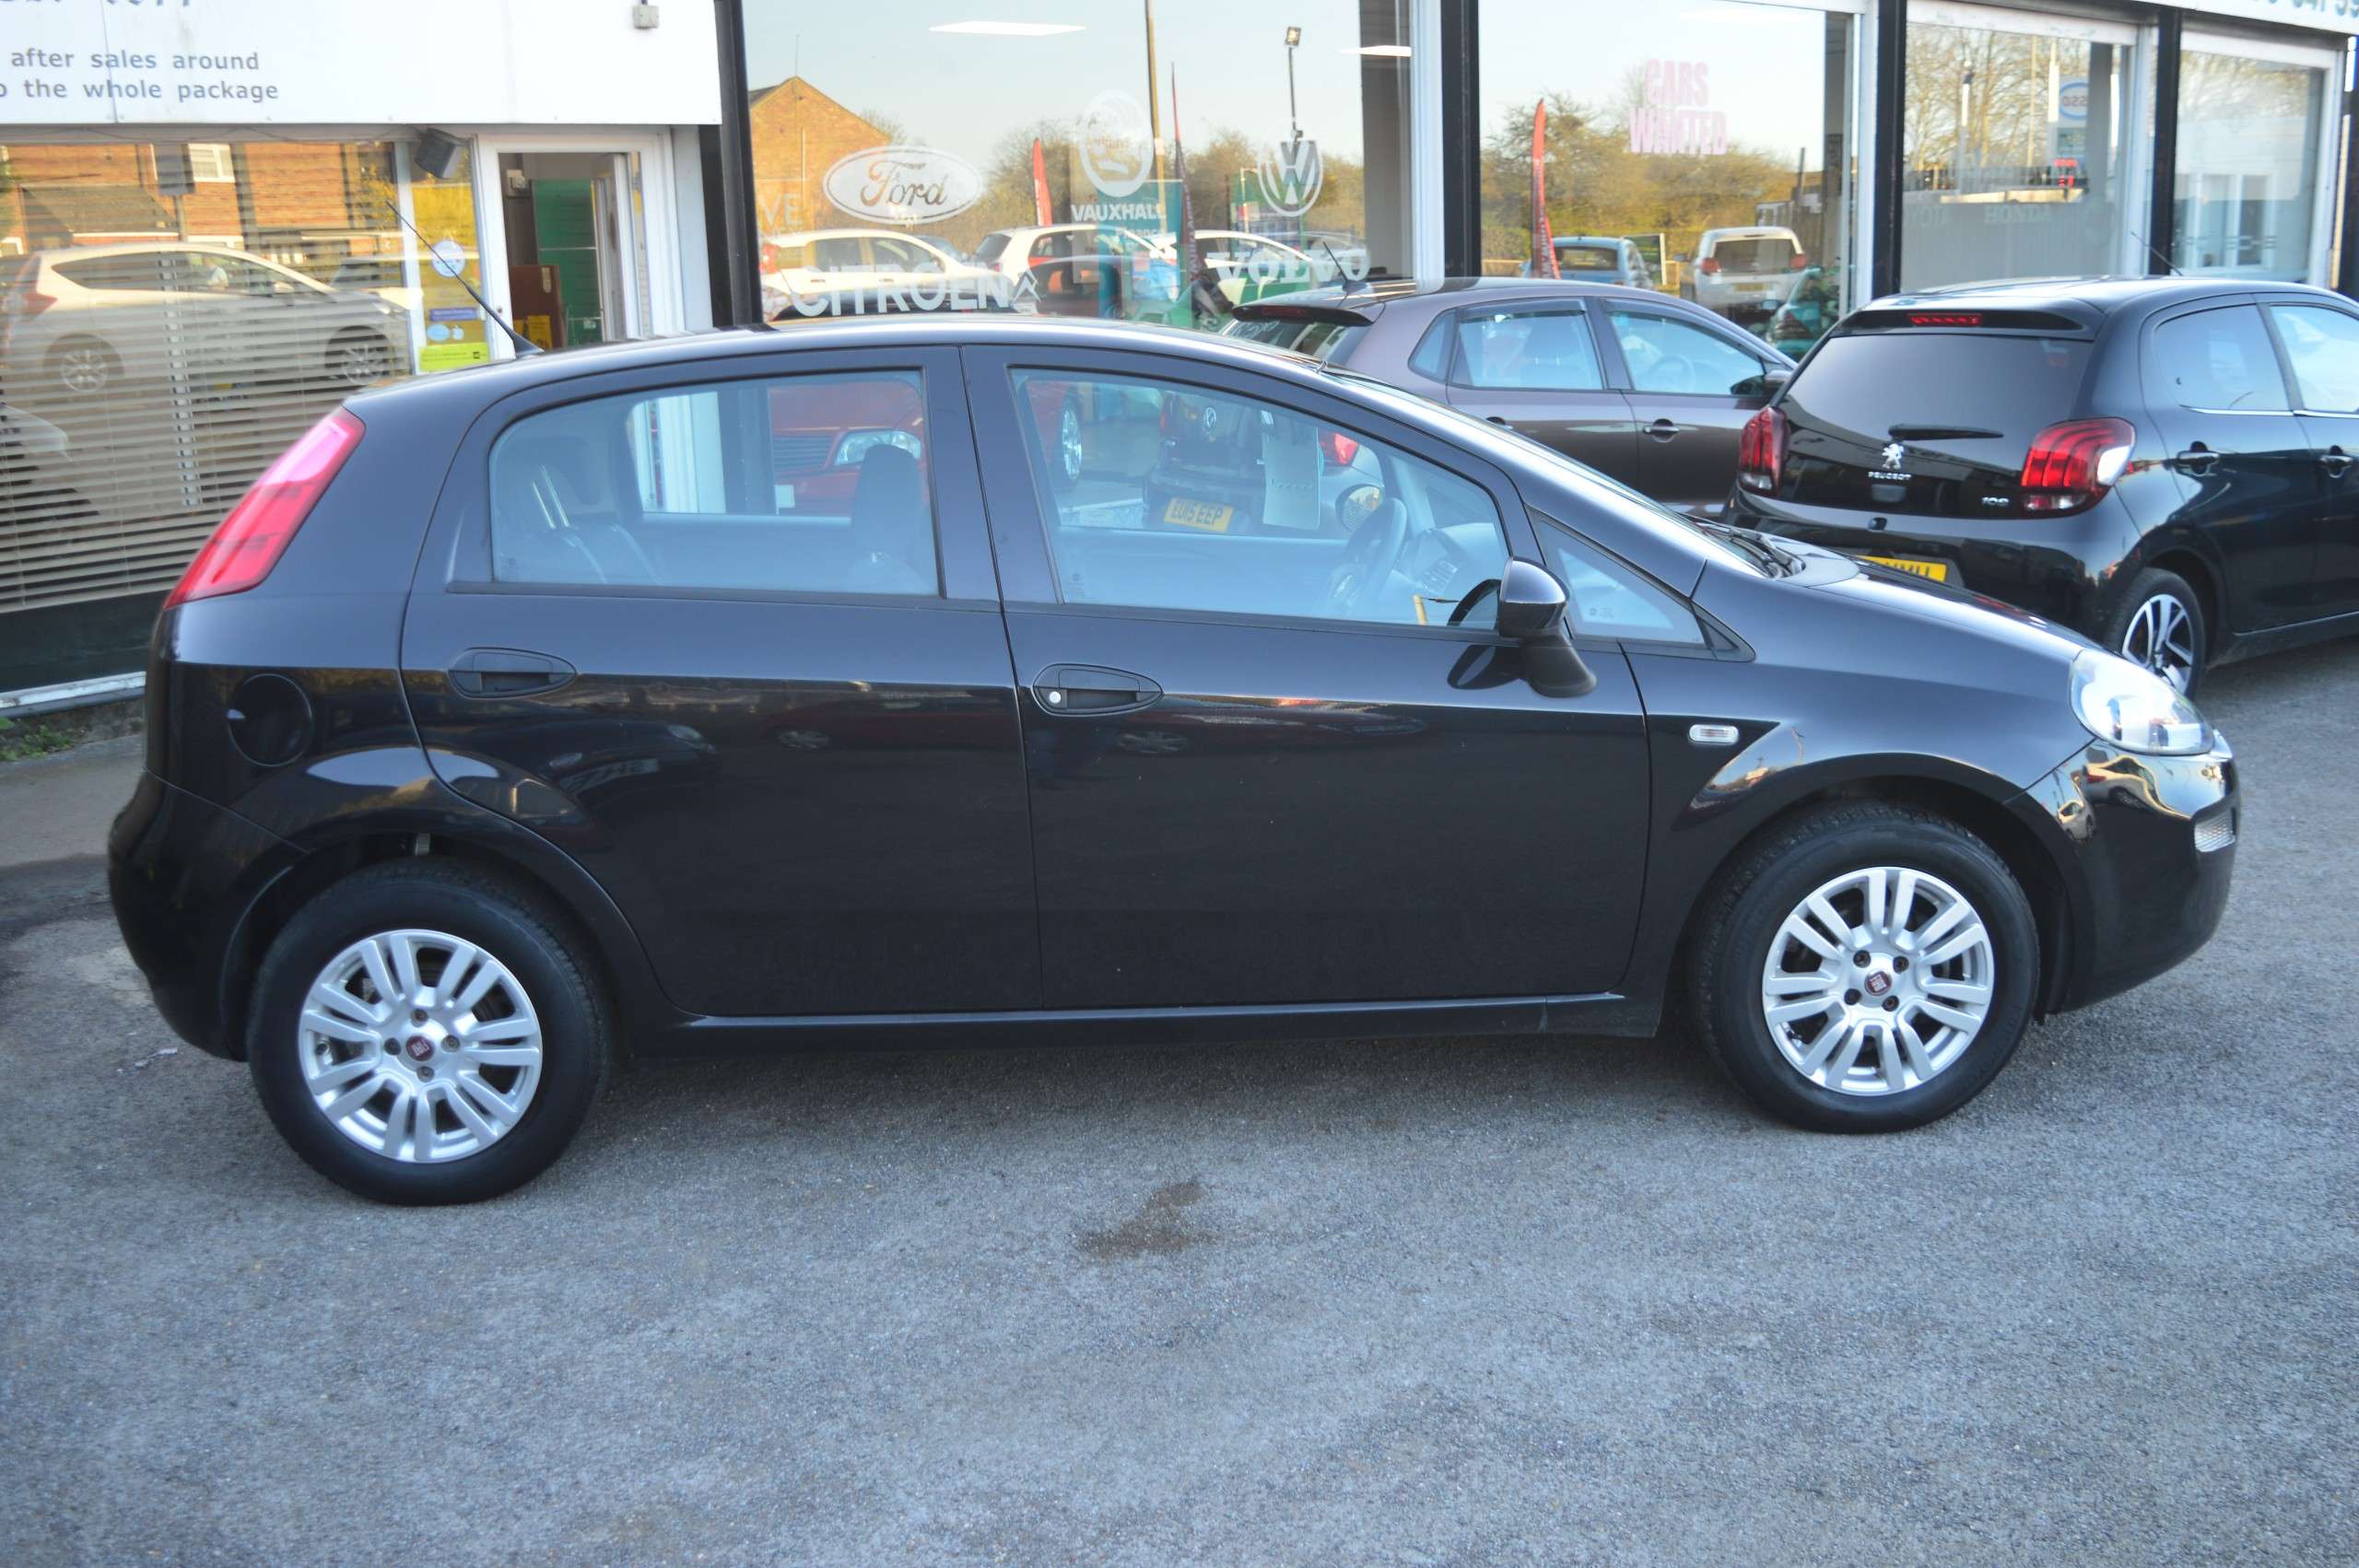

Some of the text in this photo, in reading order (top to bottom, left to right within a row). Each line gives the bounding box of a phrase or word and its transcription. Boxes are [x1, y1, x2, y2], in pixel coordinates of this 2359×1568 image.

[11, 48, 259, 70] after sales around
[24, 79, 67, 99] the
[83, 79, 162, 99] whole
[178, 81, 278, 103] package
[1646, 58, 1709, 107] CARS
[1629, 107, 1727, 155] WANTED
[859, 159, 949, 207] Ford
[1070, 203, 1168, 222] VAUXHALL
[1206, 245, 1370, 284] VOLVO
[1867, 471, 1911, 480] PEUGEOT
